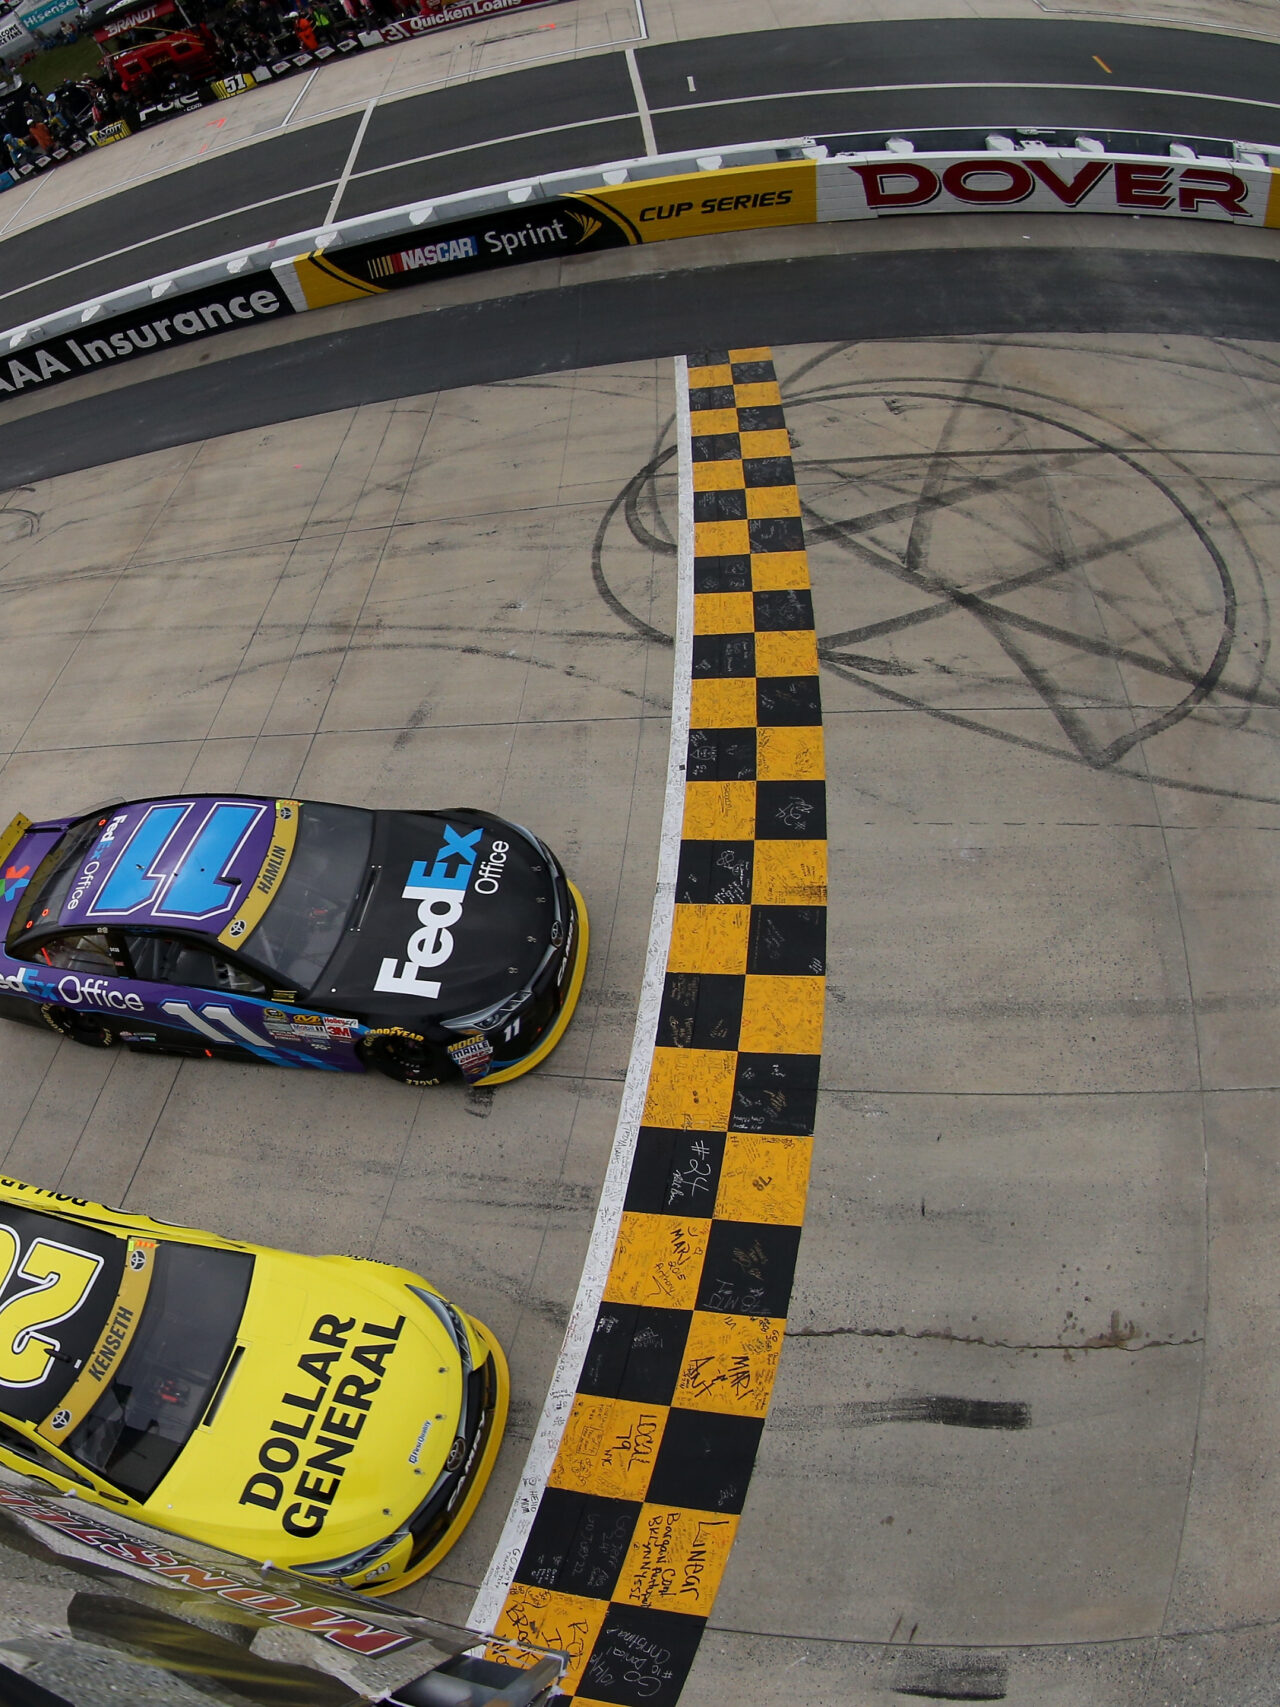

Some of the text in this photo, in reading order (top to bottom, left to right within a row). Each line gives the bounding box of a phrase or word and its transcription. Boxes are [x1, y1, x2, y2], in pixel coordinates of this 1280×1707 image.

[7, 30, 24, 43] FANS
[104, 4, 158, 38] BRANDT
[380, 24, 410, 43] 31
[410, 3, 472, 31] Quicken
[225, 74, 247, 93] 51
[639, 189, 793, 223] CUP SERIES
[848, 159, 1253, 217] DOVER
[400, 219, 568, 272] NASCAR Sprint
[66, 289, 280, 367] Insurance
[67, 814, 128, 911] FedEx Office
[86, 802, 267, 920] 11
[257, 845, 287, 895] HAMLIN
[474, 840, 510, 895] Office
[373, 824, 484, 999] FedEx
[57, 975, 145, 1012] Office
[161, 999, 277, 1049] 11
[326, 1026, 351, 1038] 3M
[364, 1026, 424, 1042] GOODYEAR
[448, 1033, 485, 1053] MOOG
[504, 1016, 520, 1042] 11
[452, 1040, 489, 1059] MAHLE
[406, 1078, 440, 1087] EAGLE
[684, 1140, 713, 1198] #24
[87, 1307, 134, 1383] KENSETH
[239, 1313, 356, 1512] DOLLAR
[282, 1314, 407, 1539] GENERAL
[365, 1562, 390, 1581] 20
